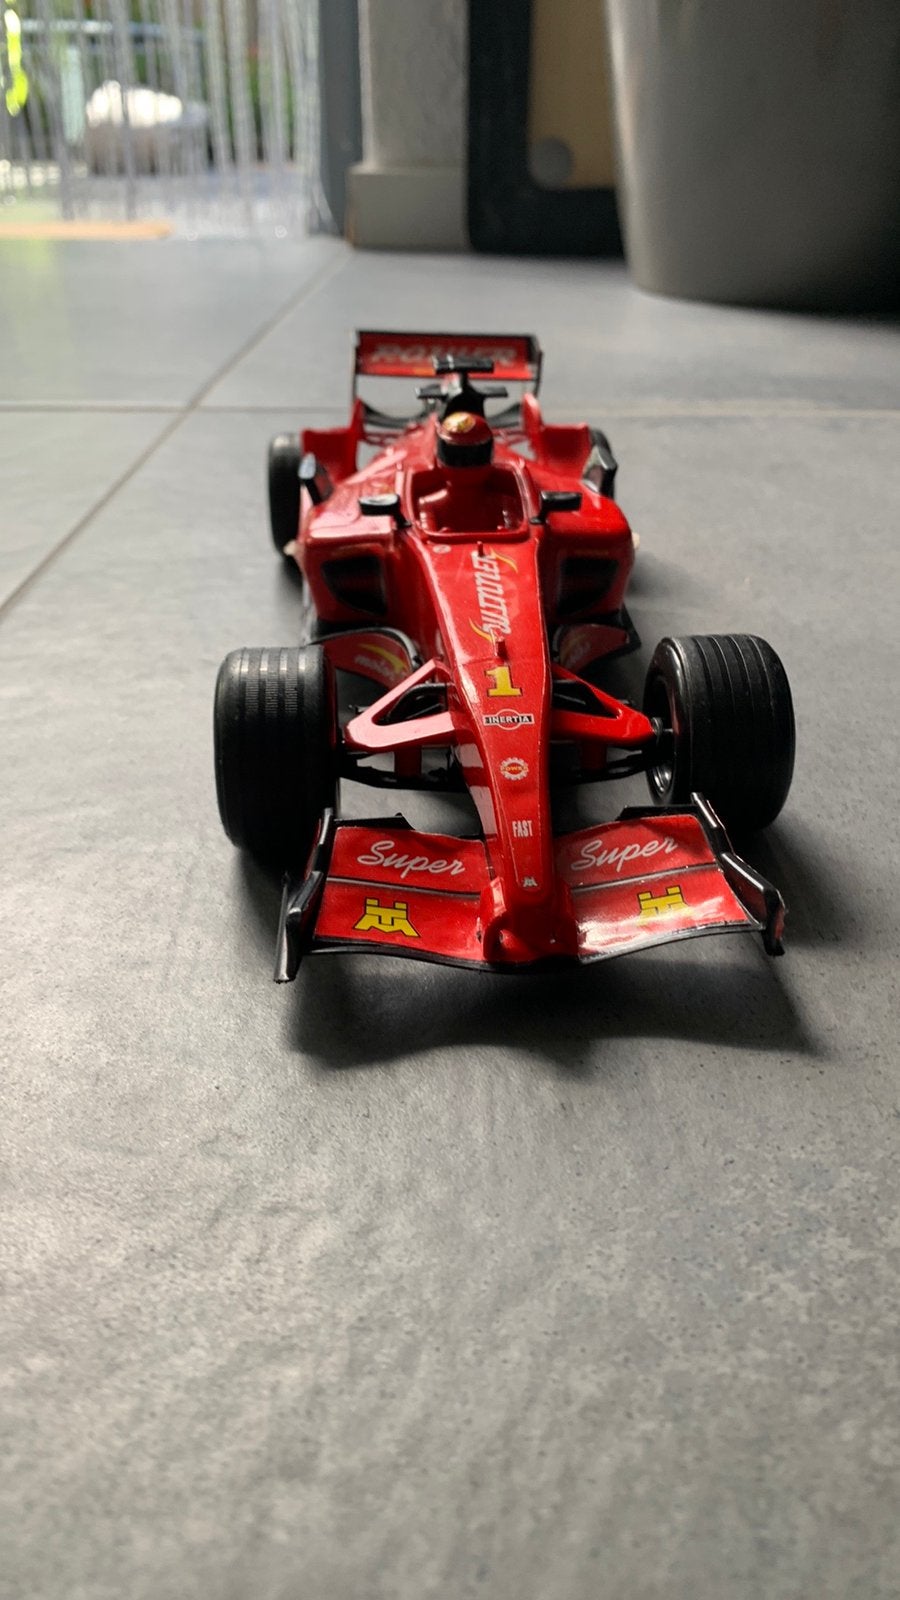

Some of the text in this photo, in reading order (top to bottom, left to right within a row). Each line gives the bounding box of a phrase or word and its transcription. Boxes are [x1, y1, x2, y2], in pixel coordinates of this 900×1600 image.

[484, 665, 523, 698] 1
[488, 715, 530, 725] INERTIA
[512, 820, 533, 838] FAST
[357, 840, 465, 879] Super
[571, 837, 678, 873] Super
